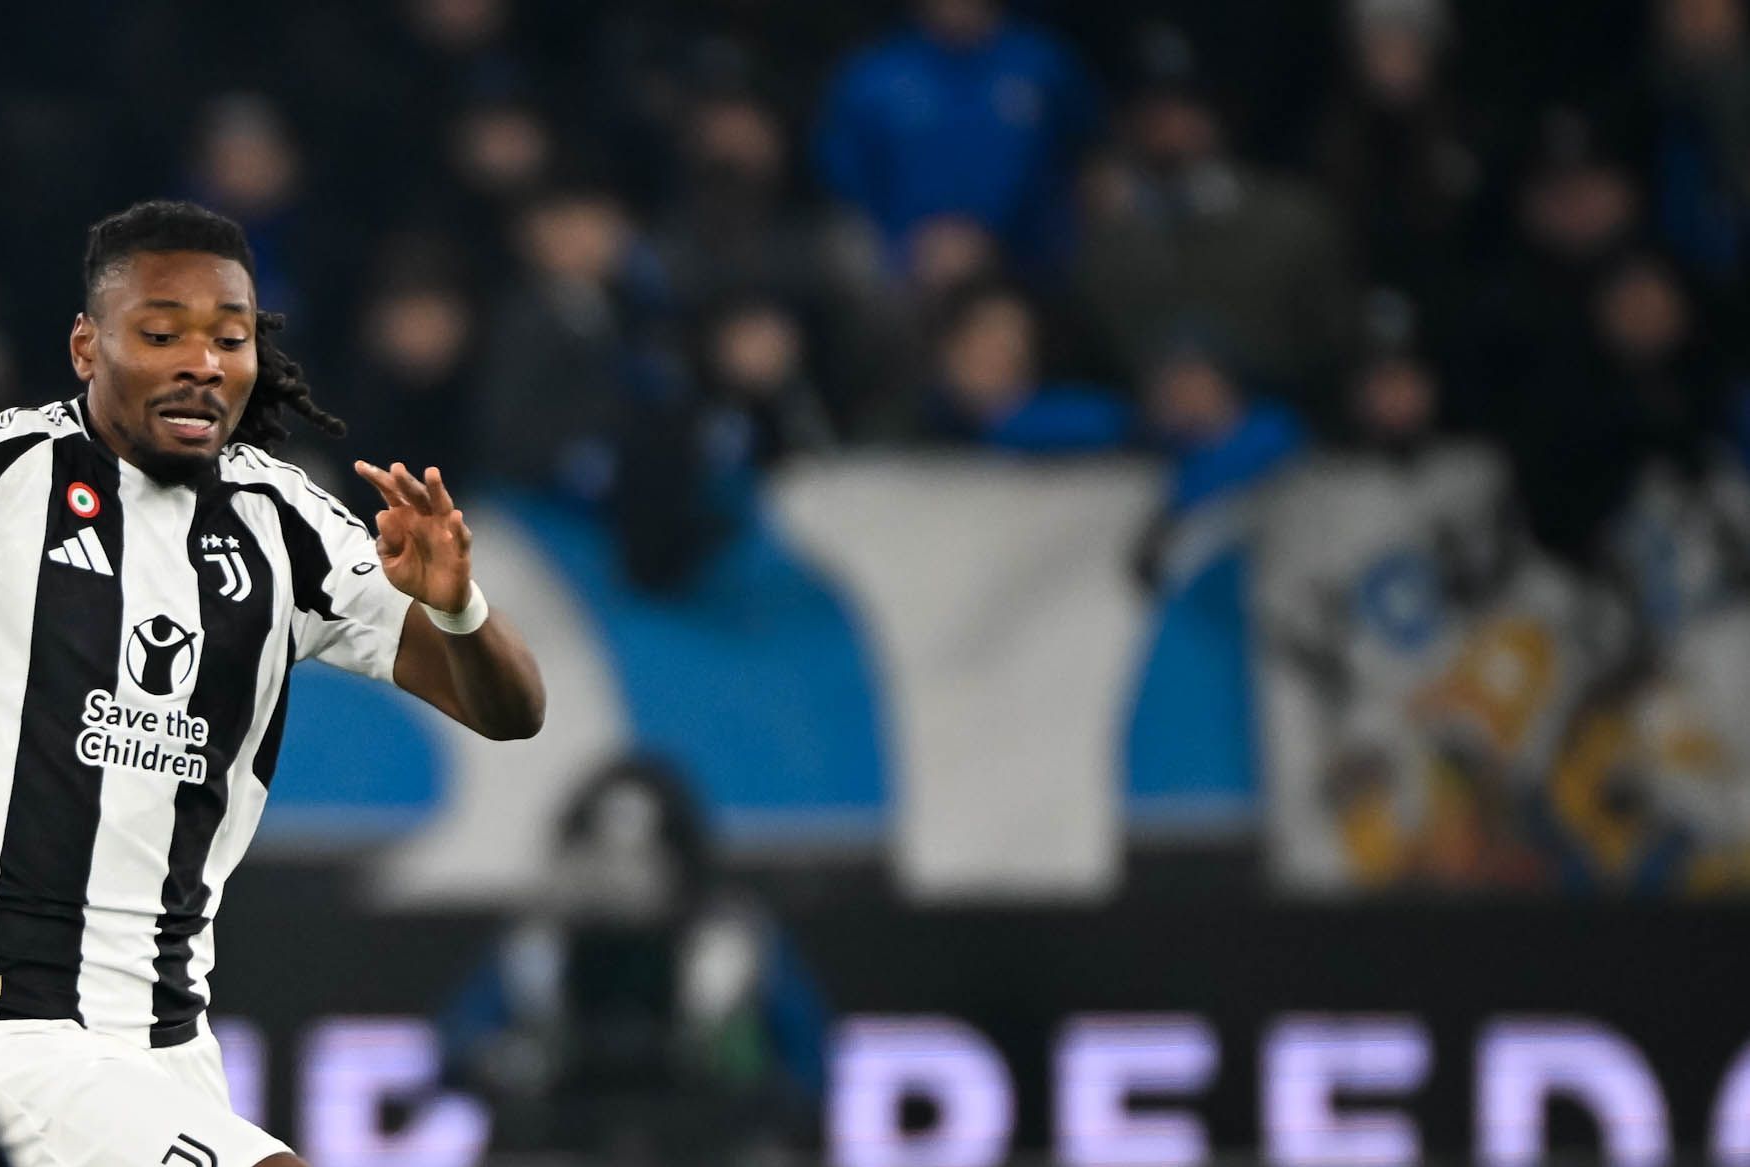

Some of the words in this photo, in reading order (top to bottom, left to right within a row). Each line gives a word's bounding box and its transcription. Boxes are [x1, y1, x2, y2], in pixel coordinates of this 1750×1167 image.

[86, 694, 158, 732] Save
[166, 710, 205, 742] the
[80, 732, 202, 780] Children
